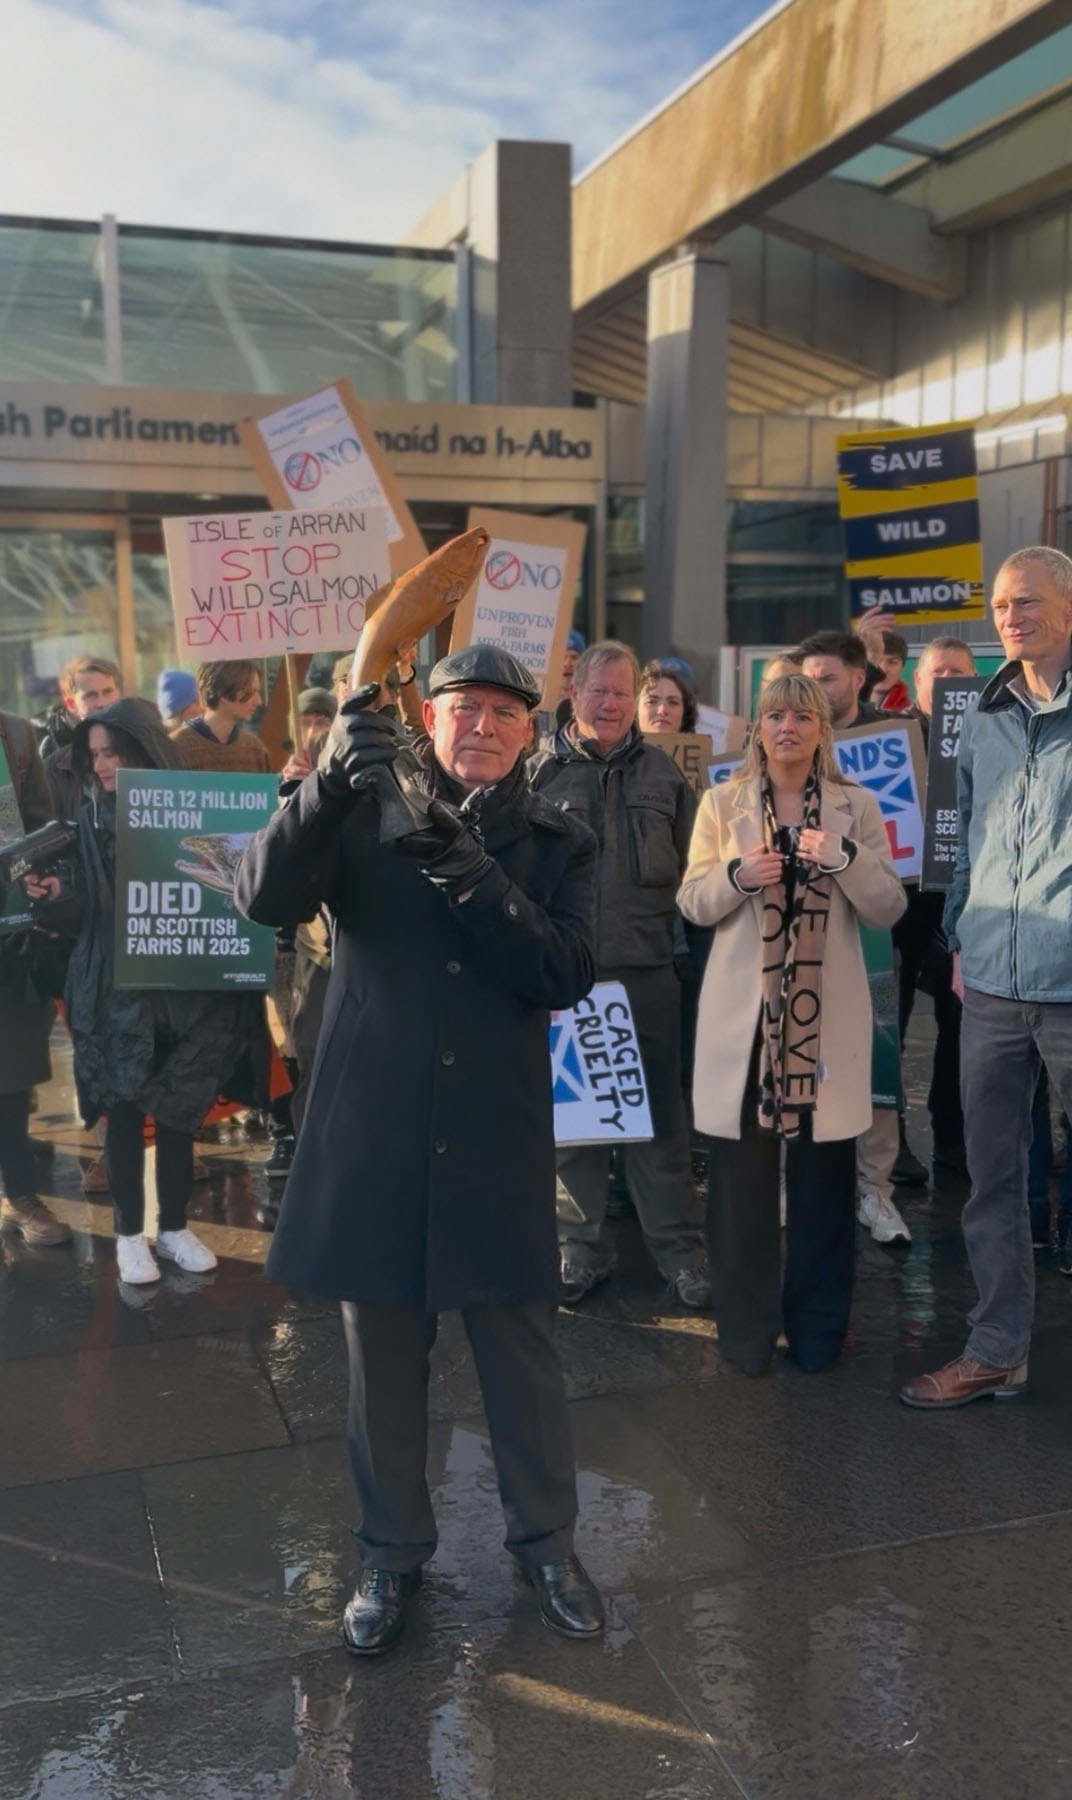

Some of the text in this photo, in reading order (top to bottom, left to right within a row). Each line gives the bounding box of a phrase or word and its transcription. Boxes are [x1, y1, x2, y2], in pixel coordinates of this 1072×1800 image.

[316, 437, 362, 475] NO
[450, 433, 487, 455] na
[496, 427, 592, 459] h-Alba
[870, 448, 943, 473] SAVE
[187, 518, 255, 543] ISLE
[288, 511, 367, 537] ARRAN
[877, 519, 947, 542] WILD
[220, 542, 342, 582] STOP
[520, 561, 562, 590] NO
[190, 573, 379, 613] WILD SALMON
[860, 582, 972, 607] SALMON
[477, 607, 555, 629] UNPROVEN
[129, 788, 268, 810] OVER 12 MILLION
[128, 809, 203, 829] SALMON
[936, 809, 958, 822] ESC
[127, 881, 202, 915] DIED
[127, 917, 238, 936] ON SCOTTISH
[127, 937, 251, 955] FARMS IN 2025
[786, 959, 823, 1097] LOVE
[572, 996, 626, 1132] CRUELTY
[604, 1001, 645, 1107] CAGED
